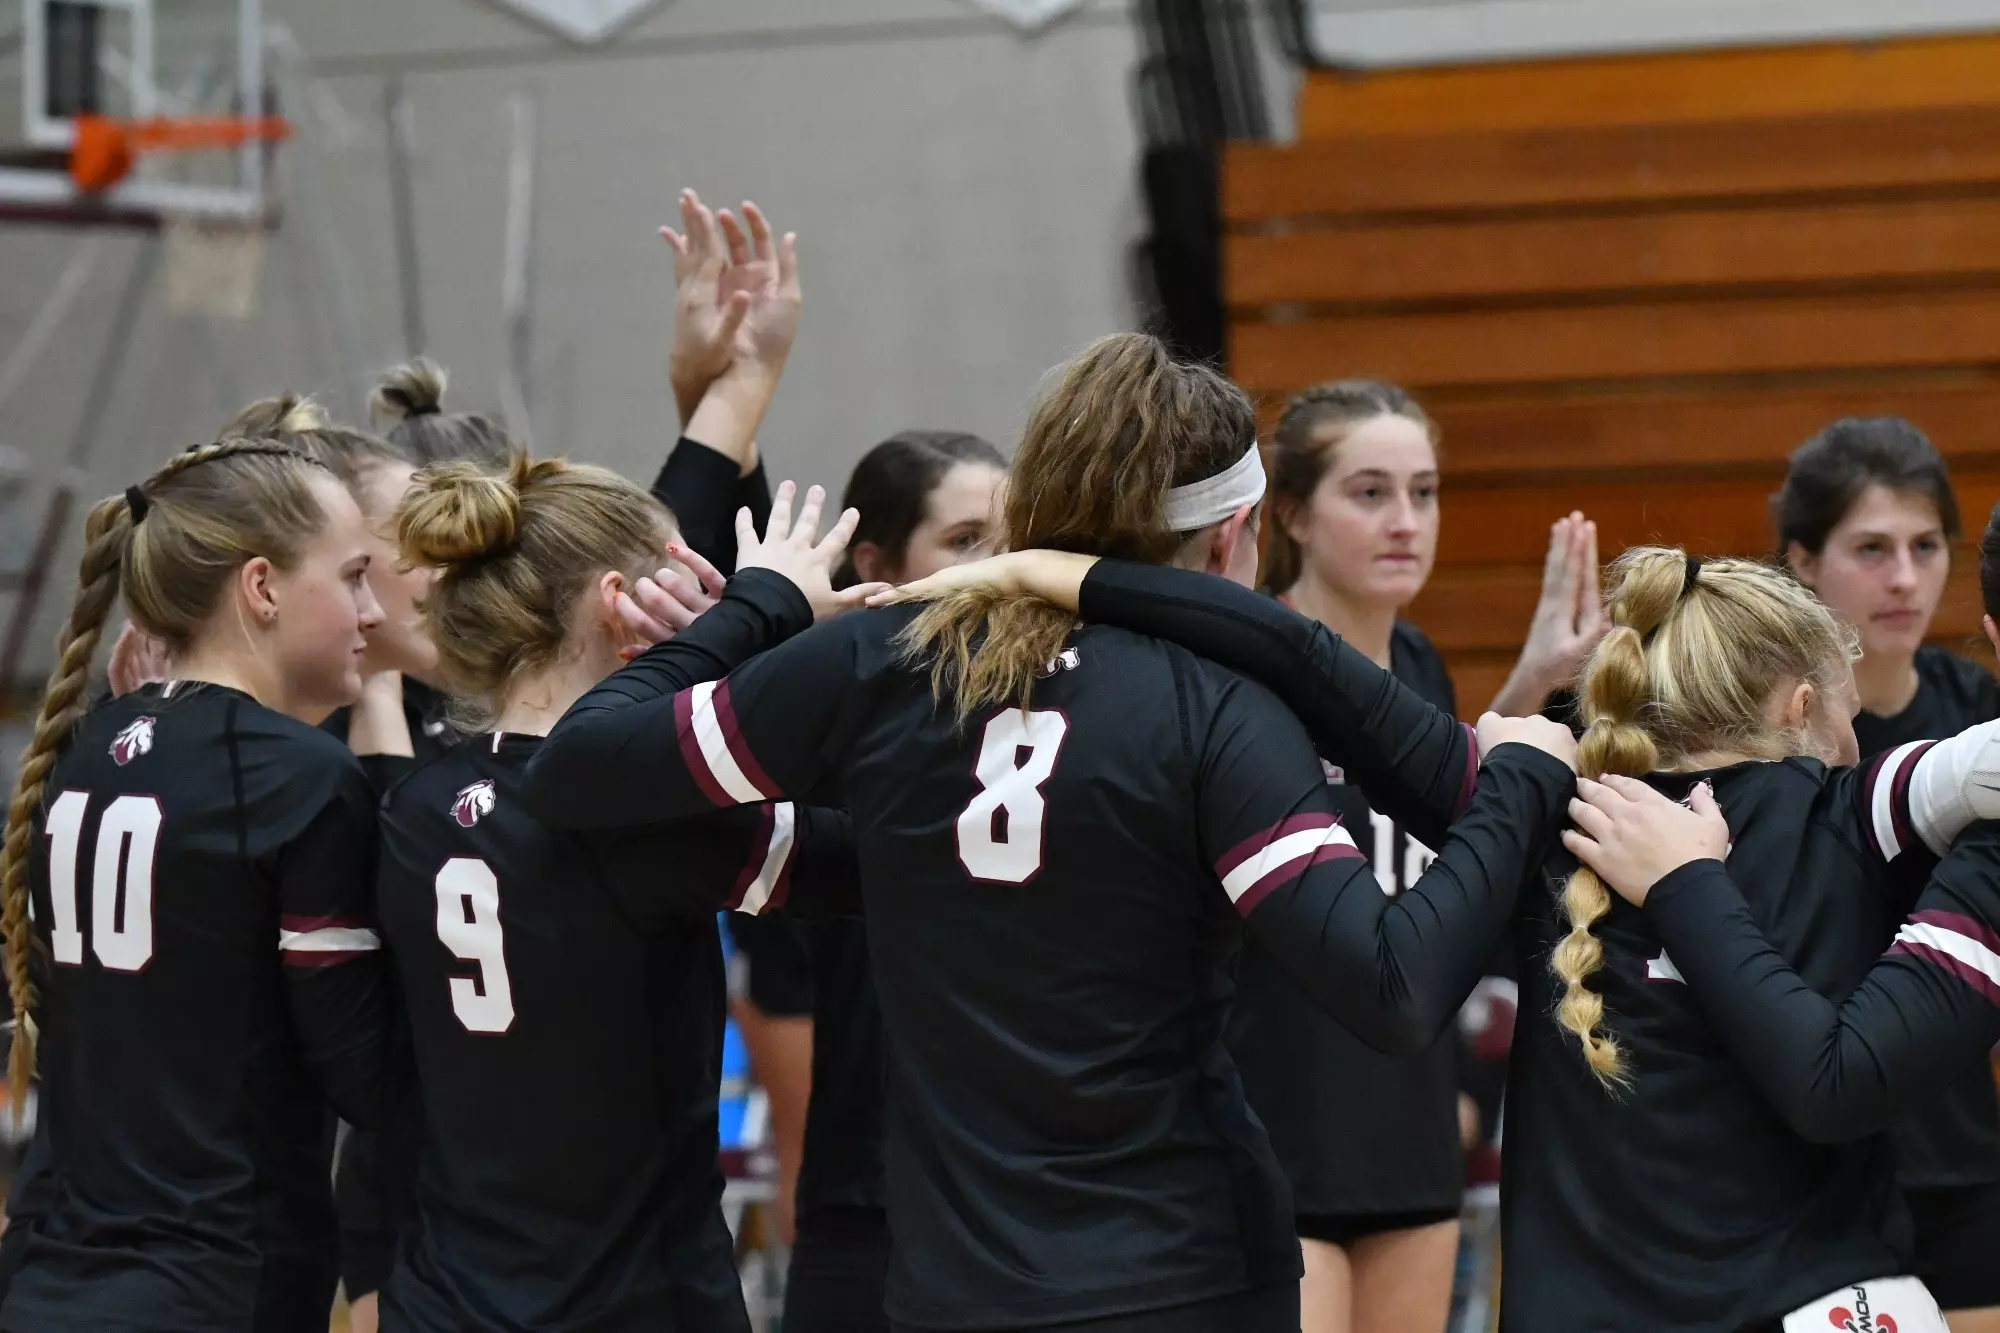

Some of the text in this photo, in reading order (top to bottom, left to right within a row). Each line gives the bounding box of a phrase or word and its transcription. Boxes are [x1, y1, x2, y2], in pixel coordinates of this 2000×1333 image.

[44, 789, 164, 974] 10
[957, 705, 1069, 886] 8
[434, 856, 516, 1034] 9
